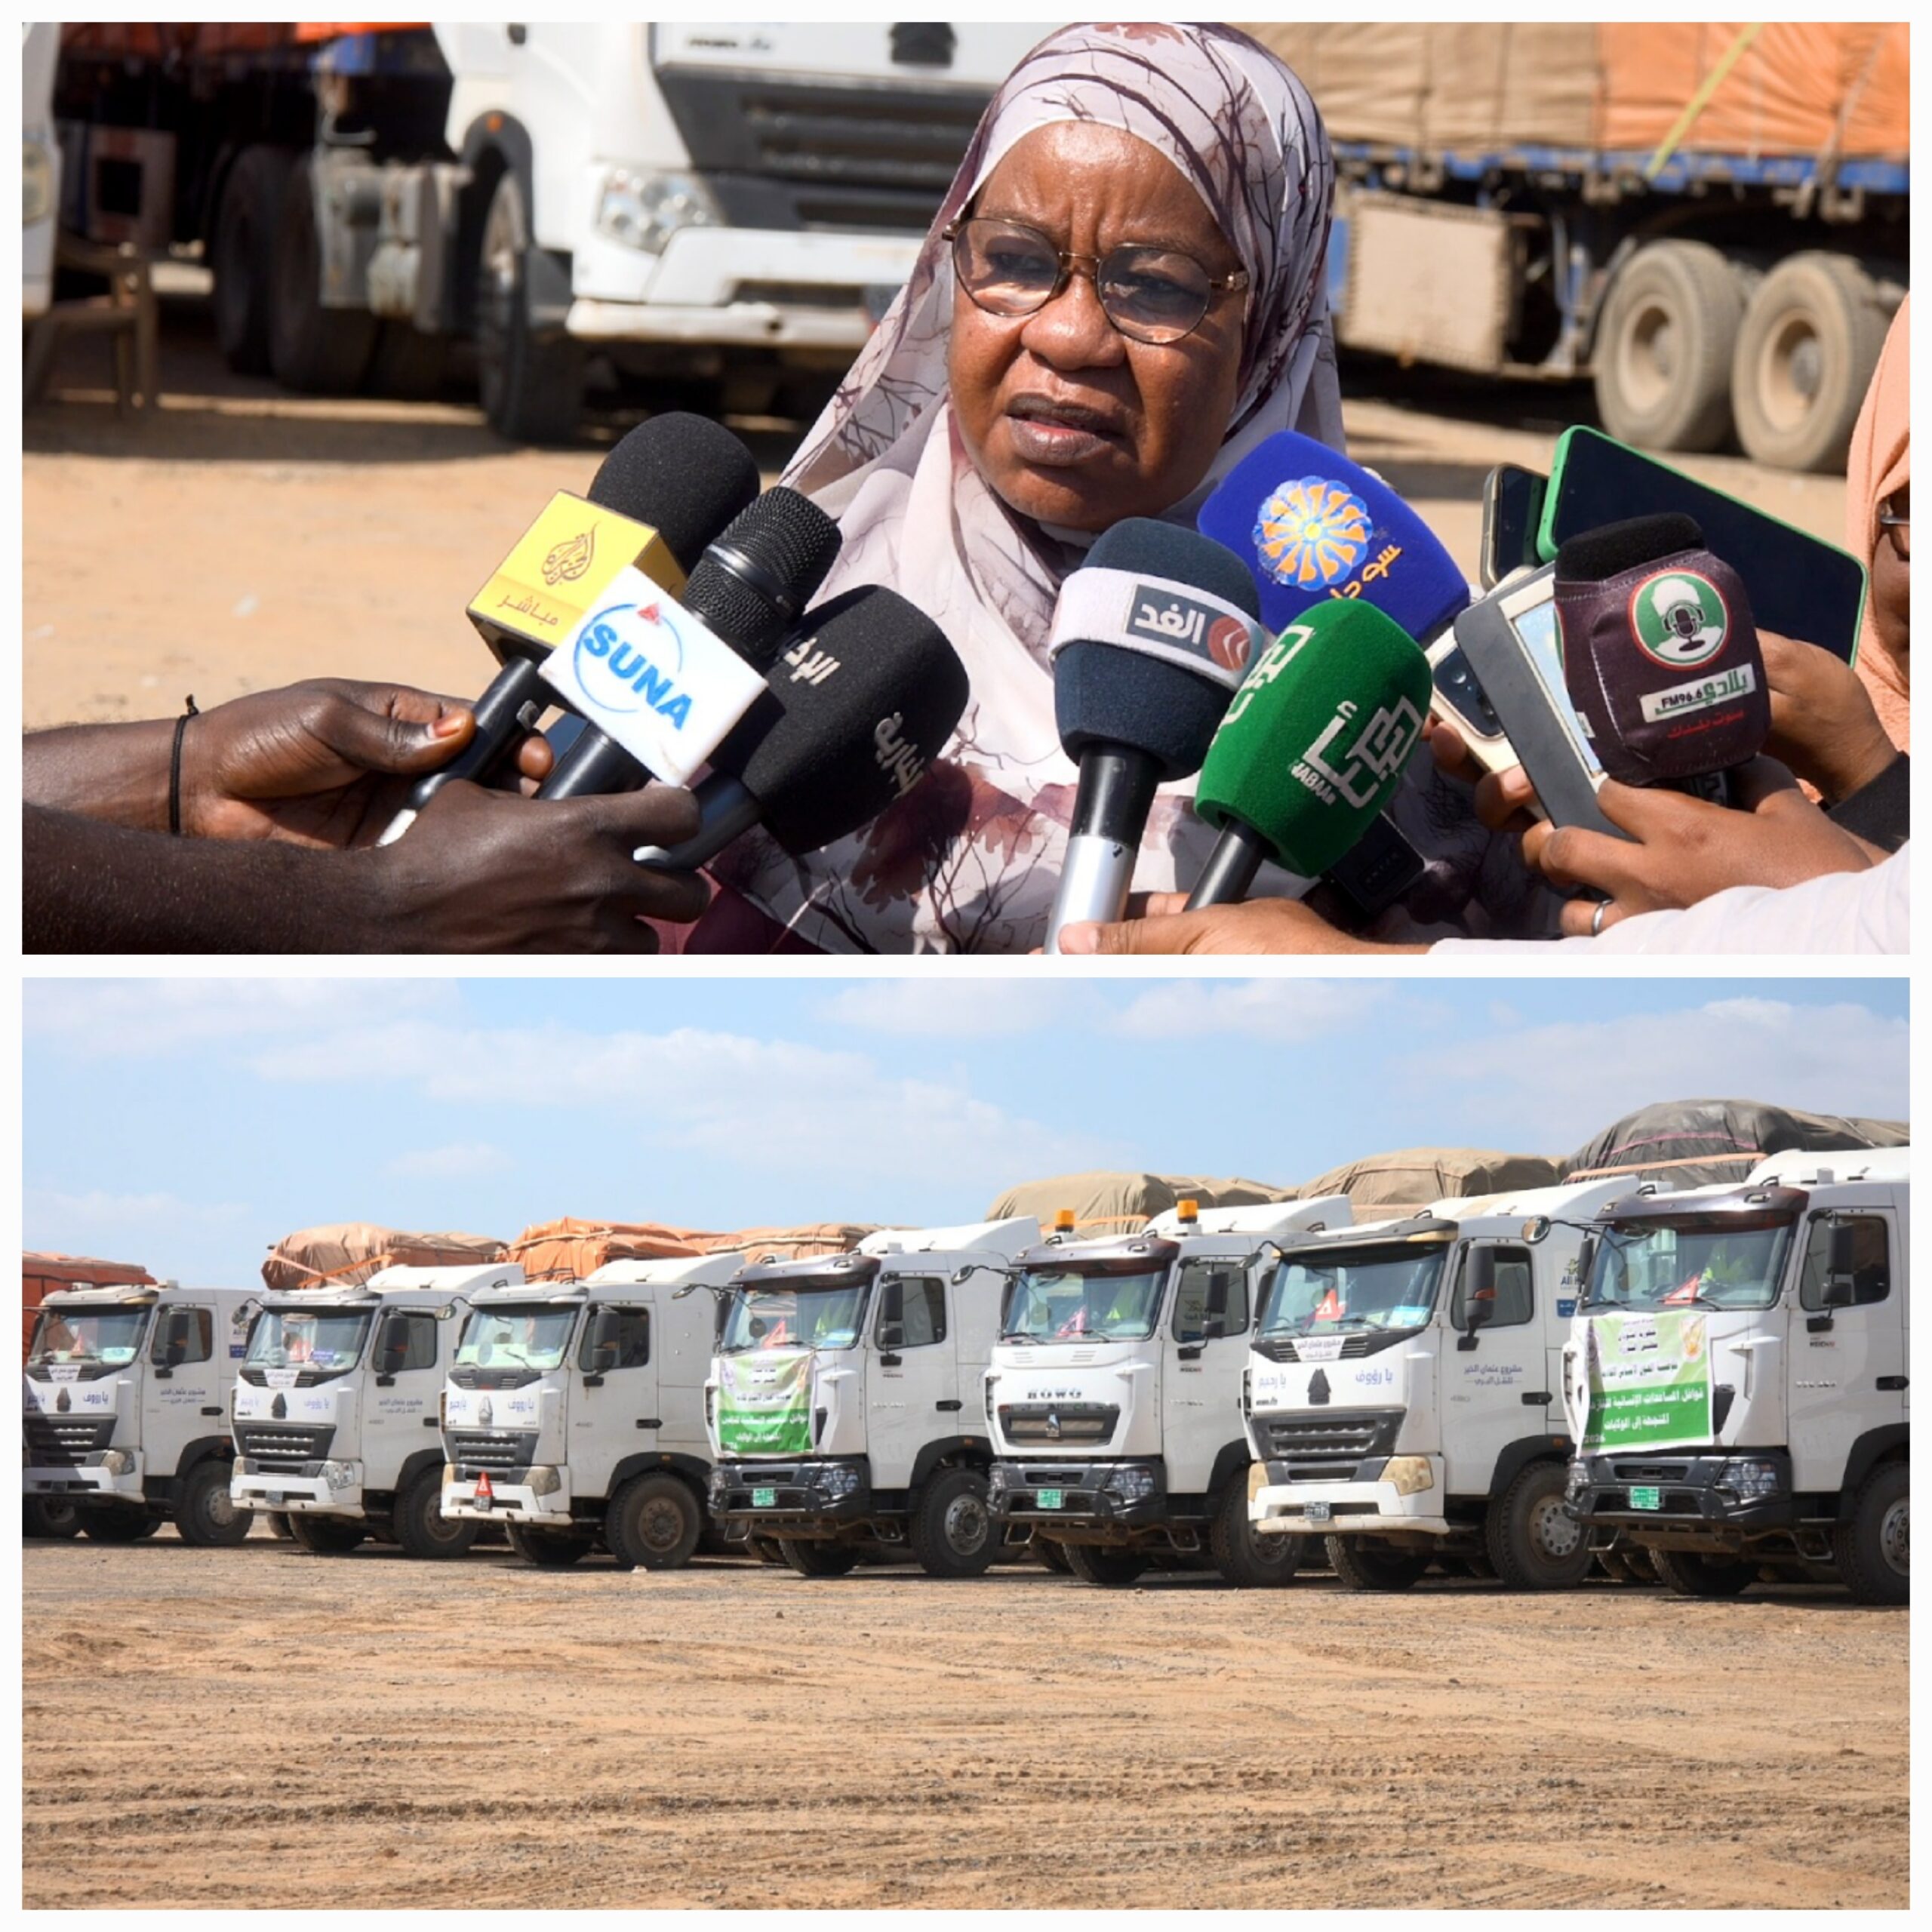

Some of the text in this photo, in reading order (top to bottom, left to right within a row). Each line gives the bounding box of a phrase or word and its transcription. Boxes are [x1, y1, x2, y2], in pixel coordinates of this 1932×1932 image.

[1330, 543, 1403, 598] سودا
[497, 595, 559, 626] مباشر
[1134, 603, 1206, 645] الغد
[583, 623, 693, 731] SUNA
[1661, 688, 1703, 709] FM96.6
